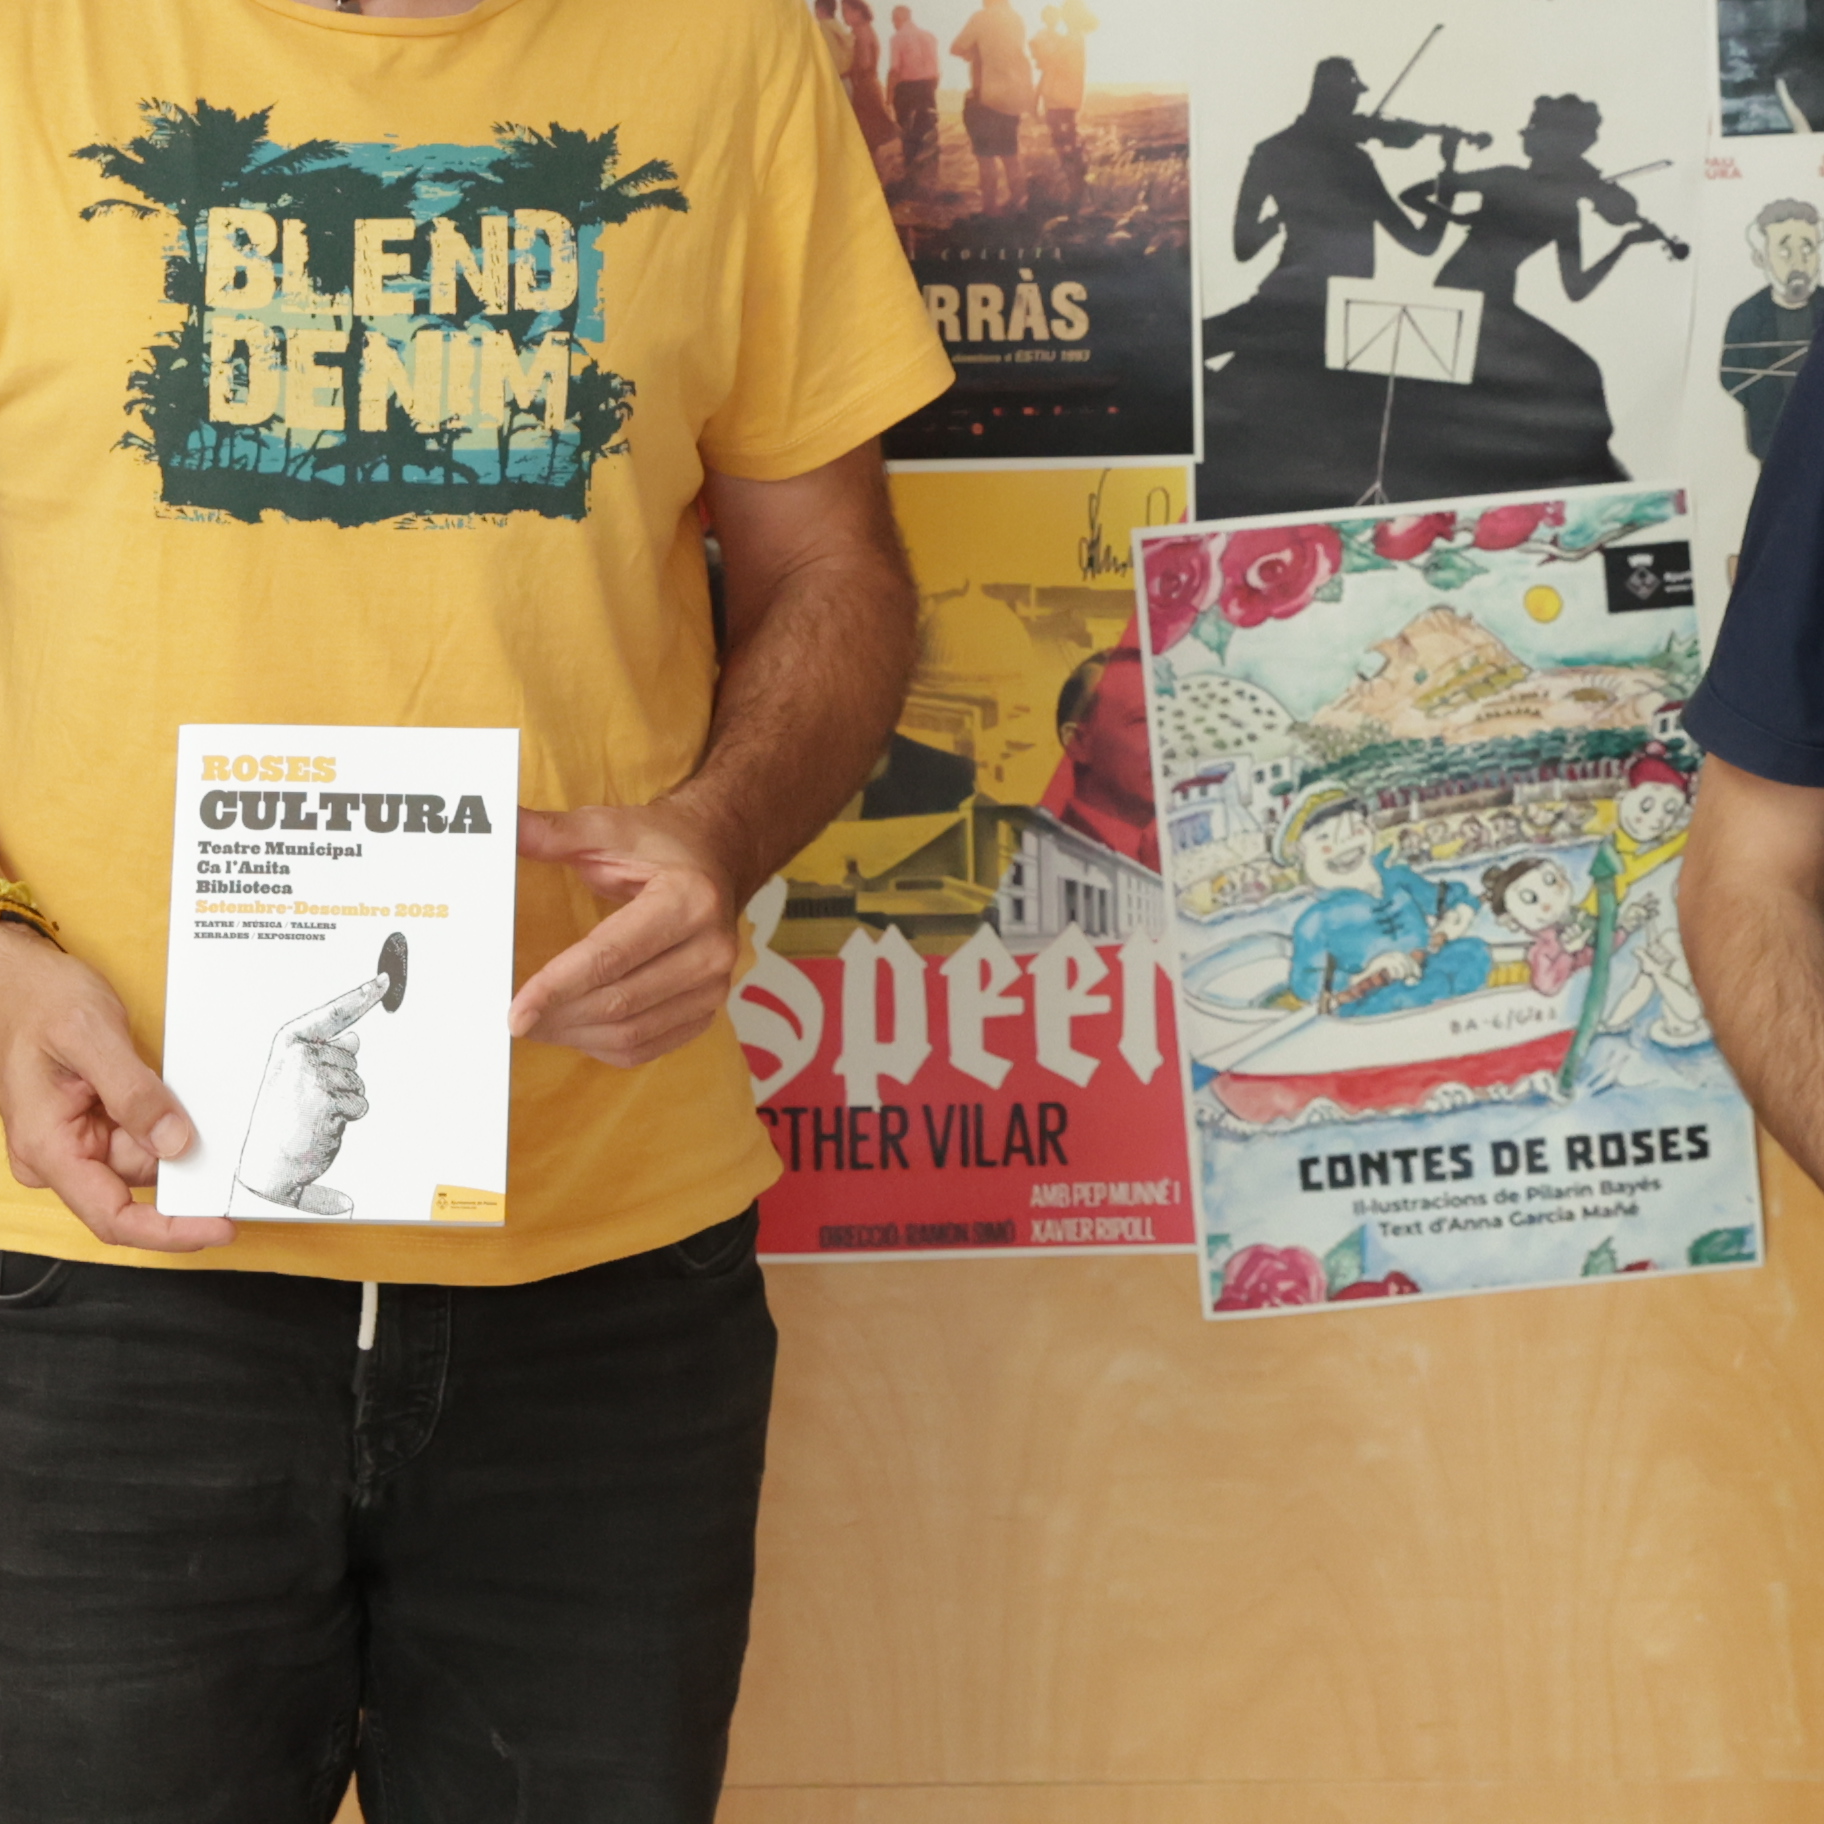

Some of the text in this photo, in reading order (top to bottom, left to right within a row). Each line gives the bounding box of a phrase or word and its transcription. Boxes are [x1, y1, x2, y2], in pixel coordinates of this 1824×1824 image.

[204, 206, 578, 316] BLEND
[208, 315, 572, 434] DENIM
[201, 755, 337, 783] ROSES
[199, 789, 492, 834] CULTURA
[198, 841, 363, 858] Teatre Municipal
[197, 860, 290, 875] Ca l'Anita
[196, 880, 293, 894] Biblioteca
[195, 900, 449, 918] Setembre-Desembre 2022
[194, 920, 235, 928] TEATRE
[291, 921, 337, 929] TALLERS
[257, 933, 326, 941] EXPOSICIONS
[922, 1102, 1069, 1168] VILAR
[1299, 1125, 1710, 1192] CONTES DE ROSES
[1030, 1183, 1071, 1208] AMB
[1073, 1182, 1108, 1207] PEP
[1493, 1188, 1520, 1204] de
[1030, 1216, 1156, 1243] XAVIER RIPOLL
[1379, 1220, 1423, 1237] Text
[1429, 1215, 1503, 1235] d'Anna
